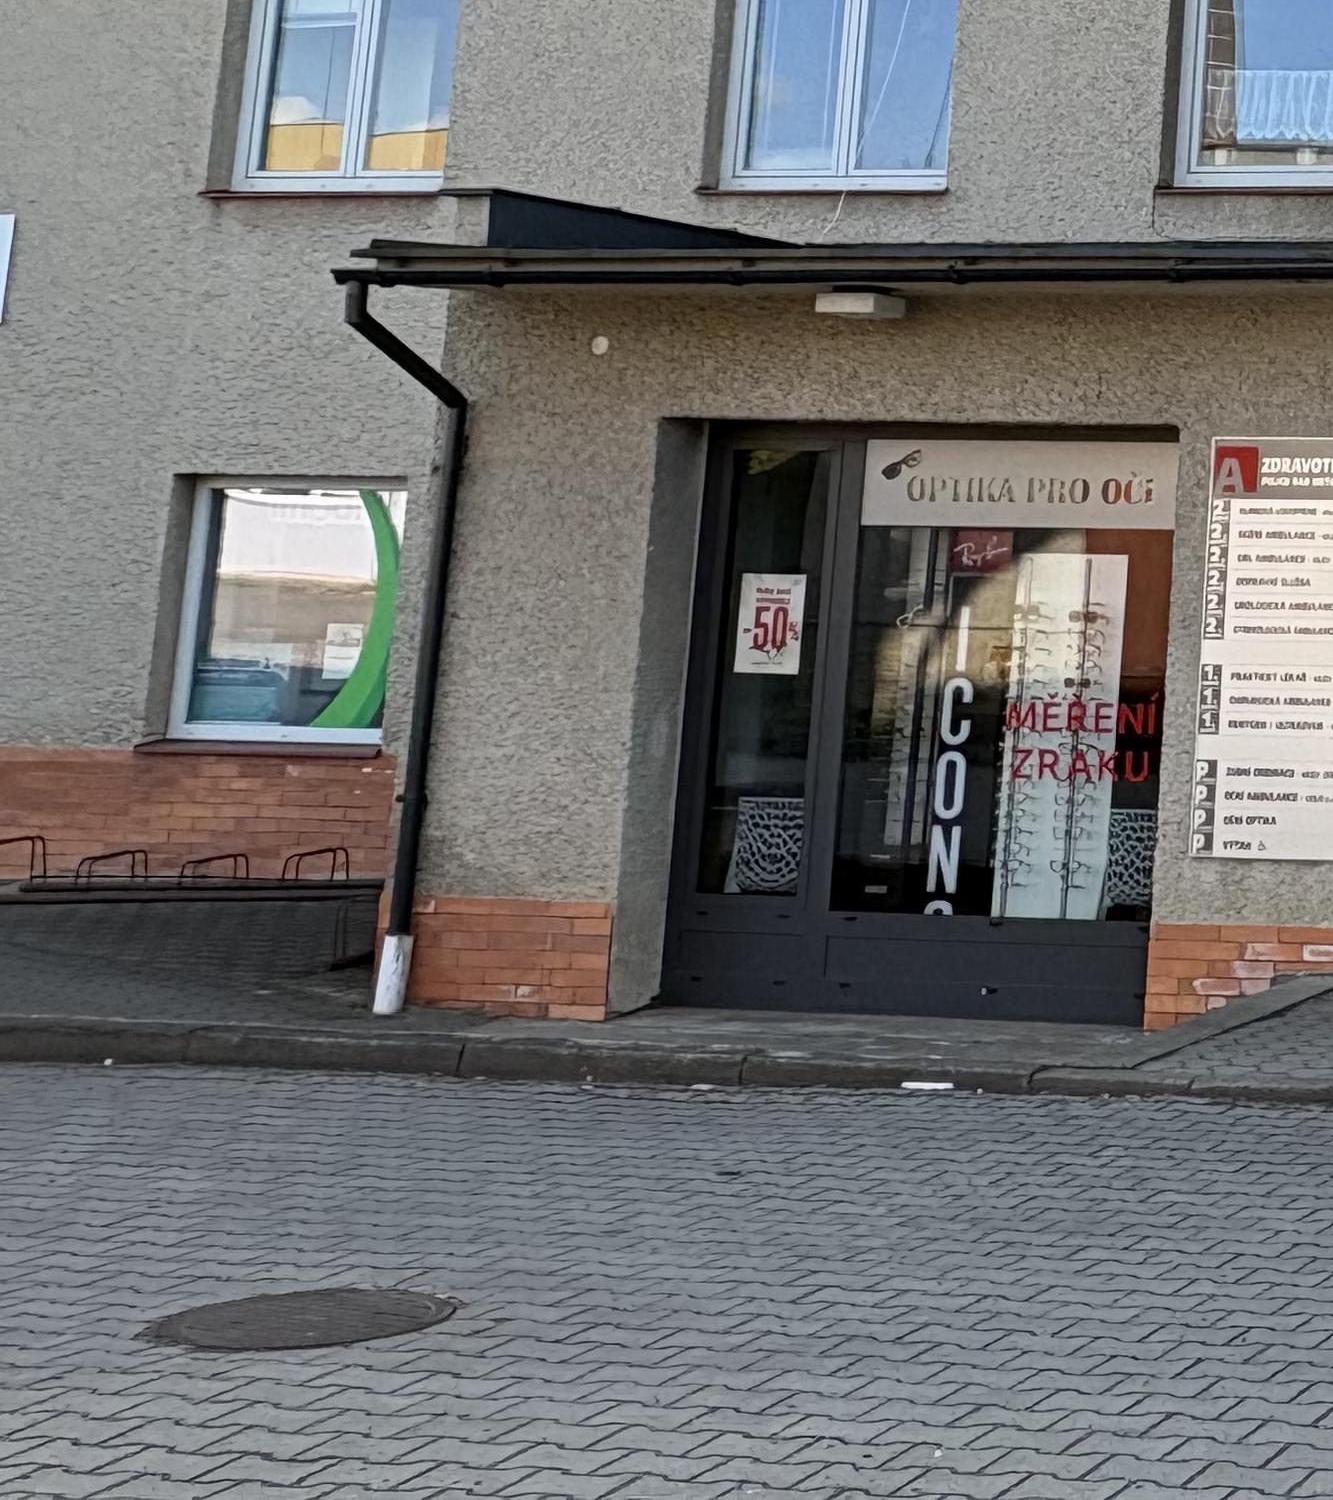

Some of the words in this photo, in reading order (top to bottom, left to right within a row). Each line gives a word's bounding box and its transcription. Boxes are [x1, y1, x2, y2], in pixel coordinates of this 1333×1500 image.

[907, 475, 1016, 503] OPTIKA
[1027, 477, 1091, 505] PRO
[1003, 692, 1160, 735] MĚŘENÍ
[922, 605, 974, 916] ICON
[1011, 748, 1149, 783] ZRAKU
